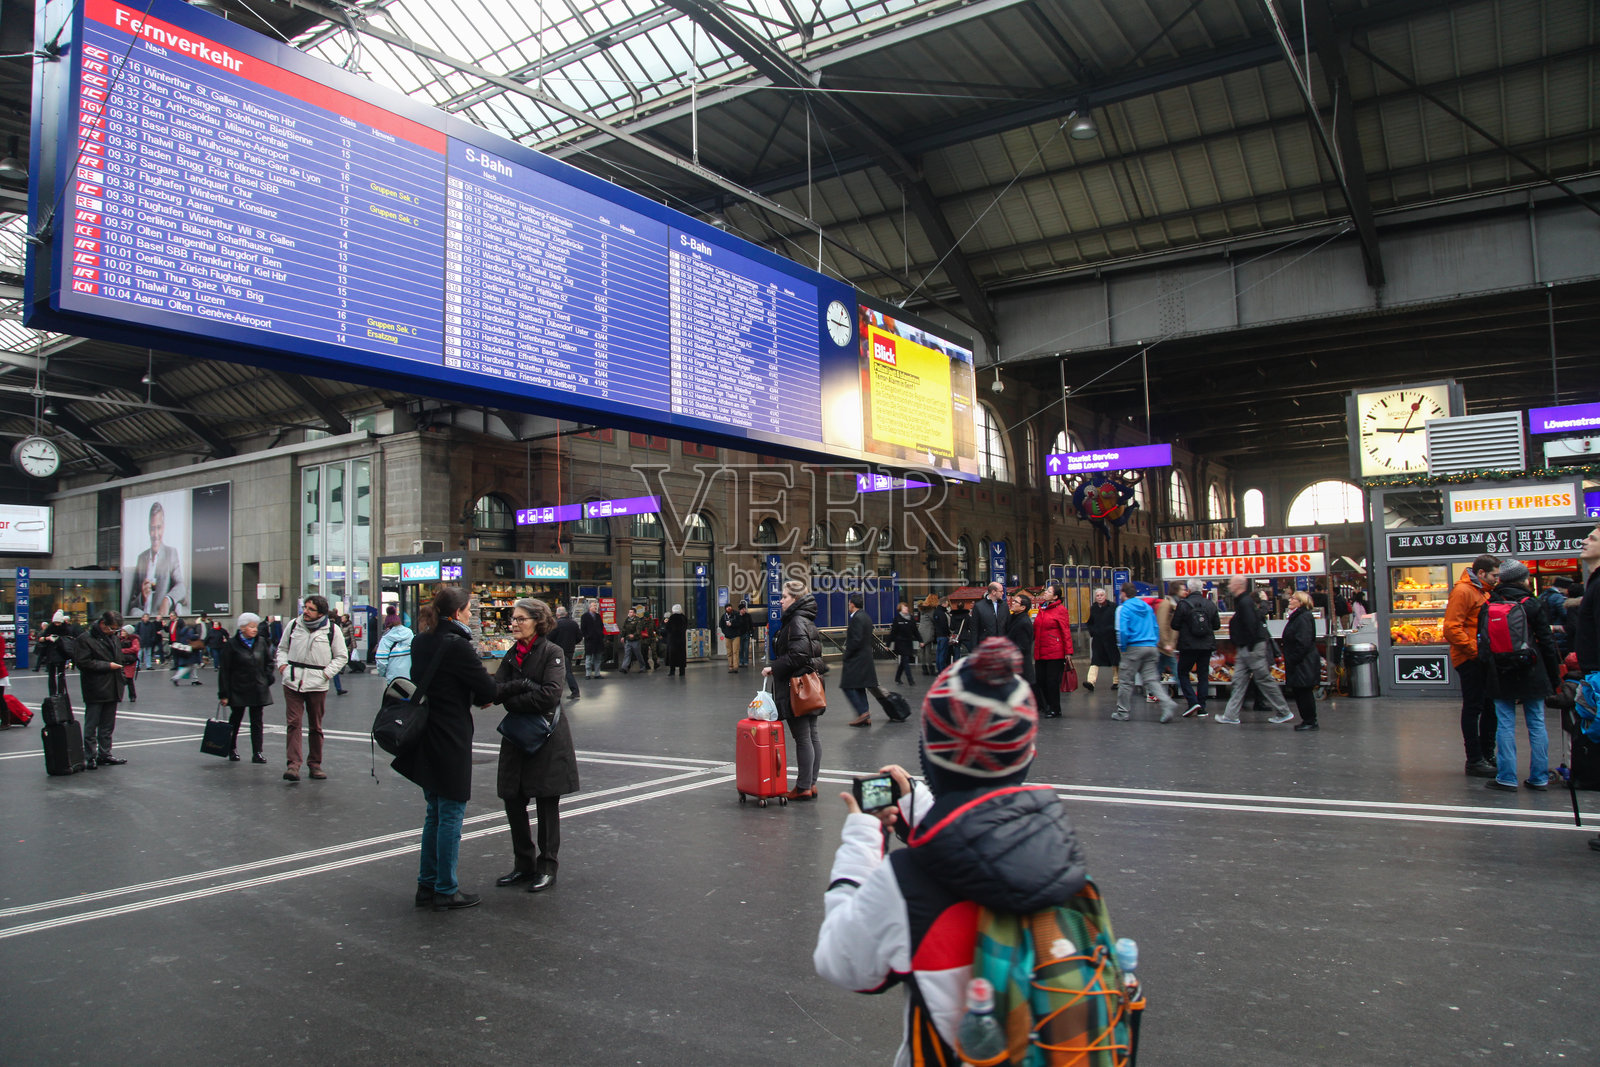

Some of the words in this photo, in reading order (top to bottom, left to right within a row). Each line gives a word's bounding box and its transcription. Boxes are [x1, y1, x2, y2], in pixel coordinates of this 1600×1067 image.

[115, 8, 243, 71] Fernverkehr
[145, 42, 167, 56] Nach
[111, 67, 140, 86] 09.30
[143, 78, 169, 96] Olten
[173, 89, 221, 116] Oensingen
[225, 108, 266, 130] Solothurn
[112, 54, 141, 72] 09.16
[143, 65, 192, 91] Winterthur
[211, 90, 238, 108] Gallen
[243, 102, 280, 123] München
[281, 116, 296, 128] Hbf
[110, 80, 140, 99] 09.32
[142, 91, 161, 108] Zug
[165, 99, 220, 126] Arth-Goldau
[225, 120, 253, 138] Milano
[255, 131, 288, 150] Centrale
[340, 116, 357, 128] Gleis
[109, 107, 138, 125] 09.34
[141, 118, 169, 135] Basel
[170, 127, 193, 143] SBB
[198, 136, 239, 158] Mulhouse
[290, 167, 300, 177] de
[302, 171, 321, 186] Lyon
[109, 121, 138, 138] 09.35
[141, 131, 174, 150] Thalwil
[178, 143, 201, 158] Baar
[205, 151, 222, 166] Zug
[227, 158, 264, 178] Rotkreuz
[269, 172, 296, 188] Luzern
[110, 94, 139, 112] 09.32
[142, 105, 165, 121] Bern
[170, 114, 213, 137] Lausanne
[370, 182, 398, 200] Gruppen
[399, 192, 413, 203] Sek.
[414, 197, 419, 205] C
[372, 128, 395, 143] Hinweis
[108, 134, 137, 152] 09.36
[140, 144, 172, 162] Baden
[176, 156, 204, 174] Brugg
[208, 165, 230, 180] Frick
[234, 173, 258, 189] Basel
[260, 181, 279, 195] SBB
[108, 148, 137, 165] 09.37
[139, 157, 179, 179] Sargans
[184, 171, 228, 194] Landquart
[232, 186, 253, 199] Chur
[465, 148, 513, 177] S-Bahn
[79, 170, 94, 180] RE
[106, 175, 135, 192] 09.38
[138, 184, 182, 206] Lenzburg
[187, 198, 214, 214] Aarau
[107, 161, 136, 178] 09.37
[139, 171, 185, 194] Flughafen
[190, 185, 234, 206] Winterthur
[239, 200, 278, 219] Konstanz
[105, 202, 134, 218] 09.40
[137, 211, 177, 229] Oerlikon
[182, 222, 212, 239] Bülach
[217, 232, 274, 254] Schaffhausen
[106, 189, 135, 205] 09.39
[138, 197, 184, 220] Flughafen
[189, 211, 234, 232] Winterthur
[238, 225, 252, 236] Wil
[270, 234, 295, 248] Gallen
[76, 225, 93, 236] ICE
[105, 230, 133, 246] 10.00
[136, 238, 164, 253] Basel
[166, 245, 188, 259] SBB
[193, 252, 232, 269] Frankfurt
[234, 262, 250, 274] Hbf
[254, 267, 270, 278] Kiel
[272, 271, 287, 282] Hbf
[105, 216, 134, 232] 09.57
[136, 224, 163, 239] Olten
[167, 232, 216, 254] Langenthal
[221, 246, 258, 265] Burgdorf
[263, 256, 282, 269] Bern
[680, 234, 712, 256] S-Bahn
[104, 244, 131, 259] 10.01
[135, 252, 176, 269] Oerlikon
[180, 262, 208, 277] Zürich
[210, 269, 252, 288] Flughafen
[104, 258, 132, 273] 10.02
[135, 265, 159, 279] Bern
[163, 272, 187, 285] Thun
[191, 278, 218, 293] Spiez
[222, 285, 242, 299] Visp
[246, 290, 264, 304] Brig
[464, 276, 480, 287] 09.25
[74, 281, 92, 292] ICN
[103, 286, 131, 300] 10.04
[134, 293, 164, 307] Aarau
[168, 300, 193, 313] Olten
[104, 272, 132, 287] 10.04
[135, 279, 168, 294] Thalwil
[172, 287, 191, 301] Zug
[195, 292, 225, 306] Luzern
[367, 329, 398, 344] Ersatzzug
[463, 339, 480, 350] 09.33
[874, 343, 896, 364] Blick
[463, 360, 480, 371] 09.35
[1084, 461, 1109, 470] Lounge
[1092, 452, 1119, 461] Service
[1455, 498, 1504, 513] BUFFET
[1509, 493, 1571, 509] EXPRESS
[1398, 532, 1509, 547] HAUSGEMAC
[1518, 530, 1556, 541] HTE
[1487, 542, 1509, 553] SA
[410, 565, 437, 577] kiosk
[535, 564, 566, 576] kiosk
[1175, 555, 1311, 577] BUFFETEXPRESS
